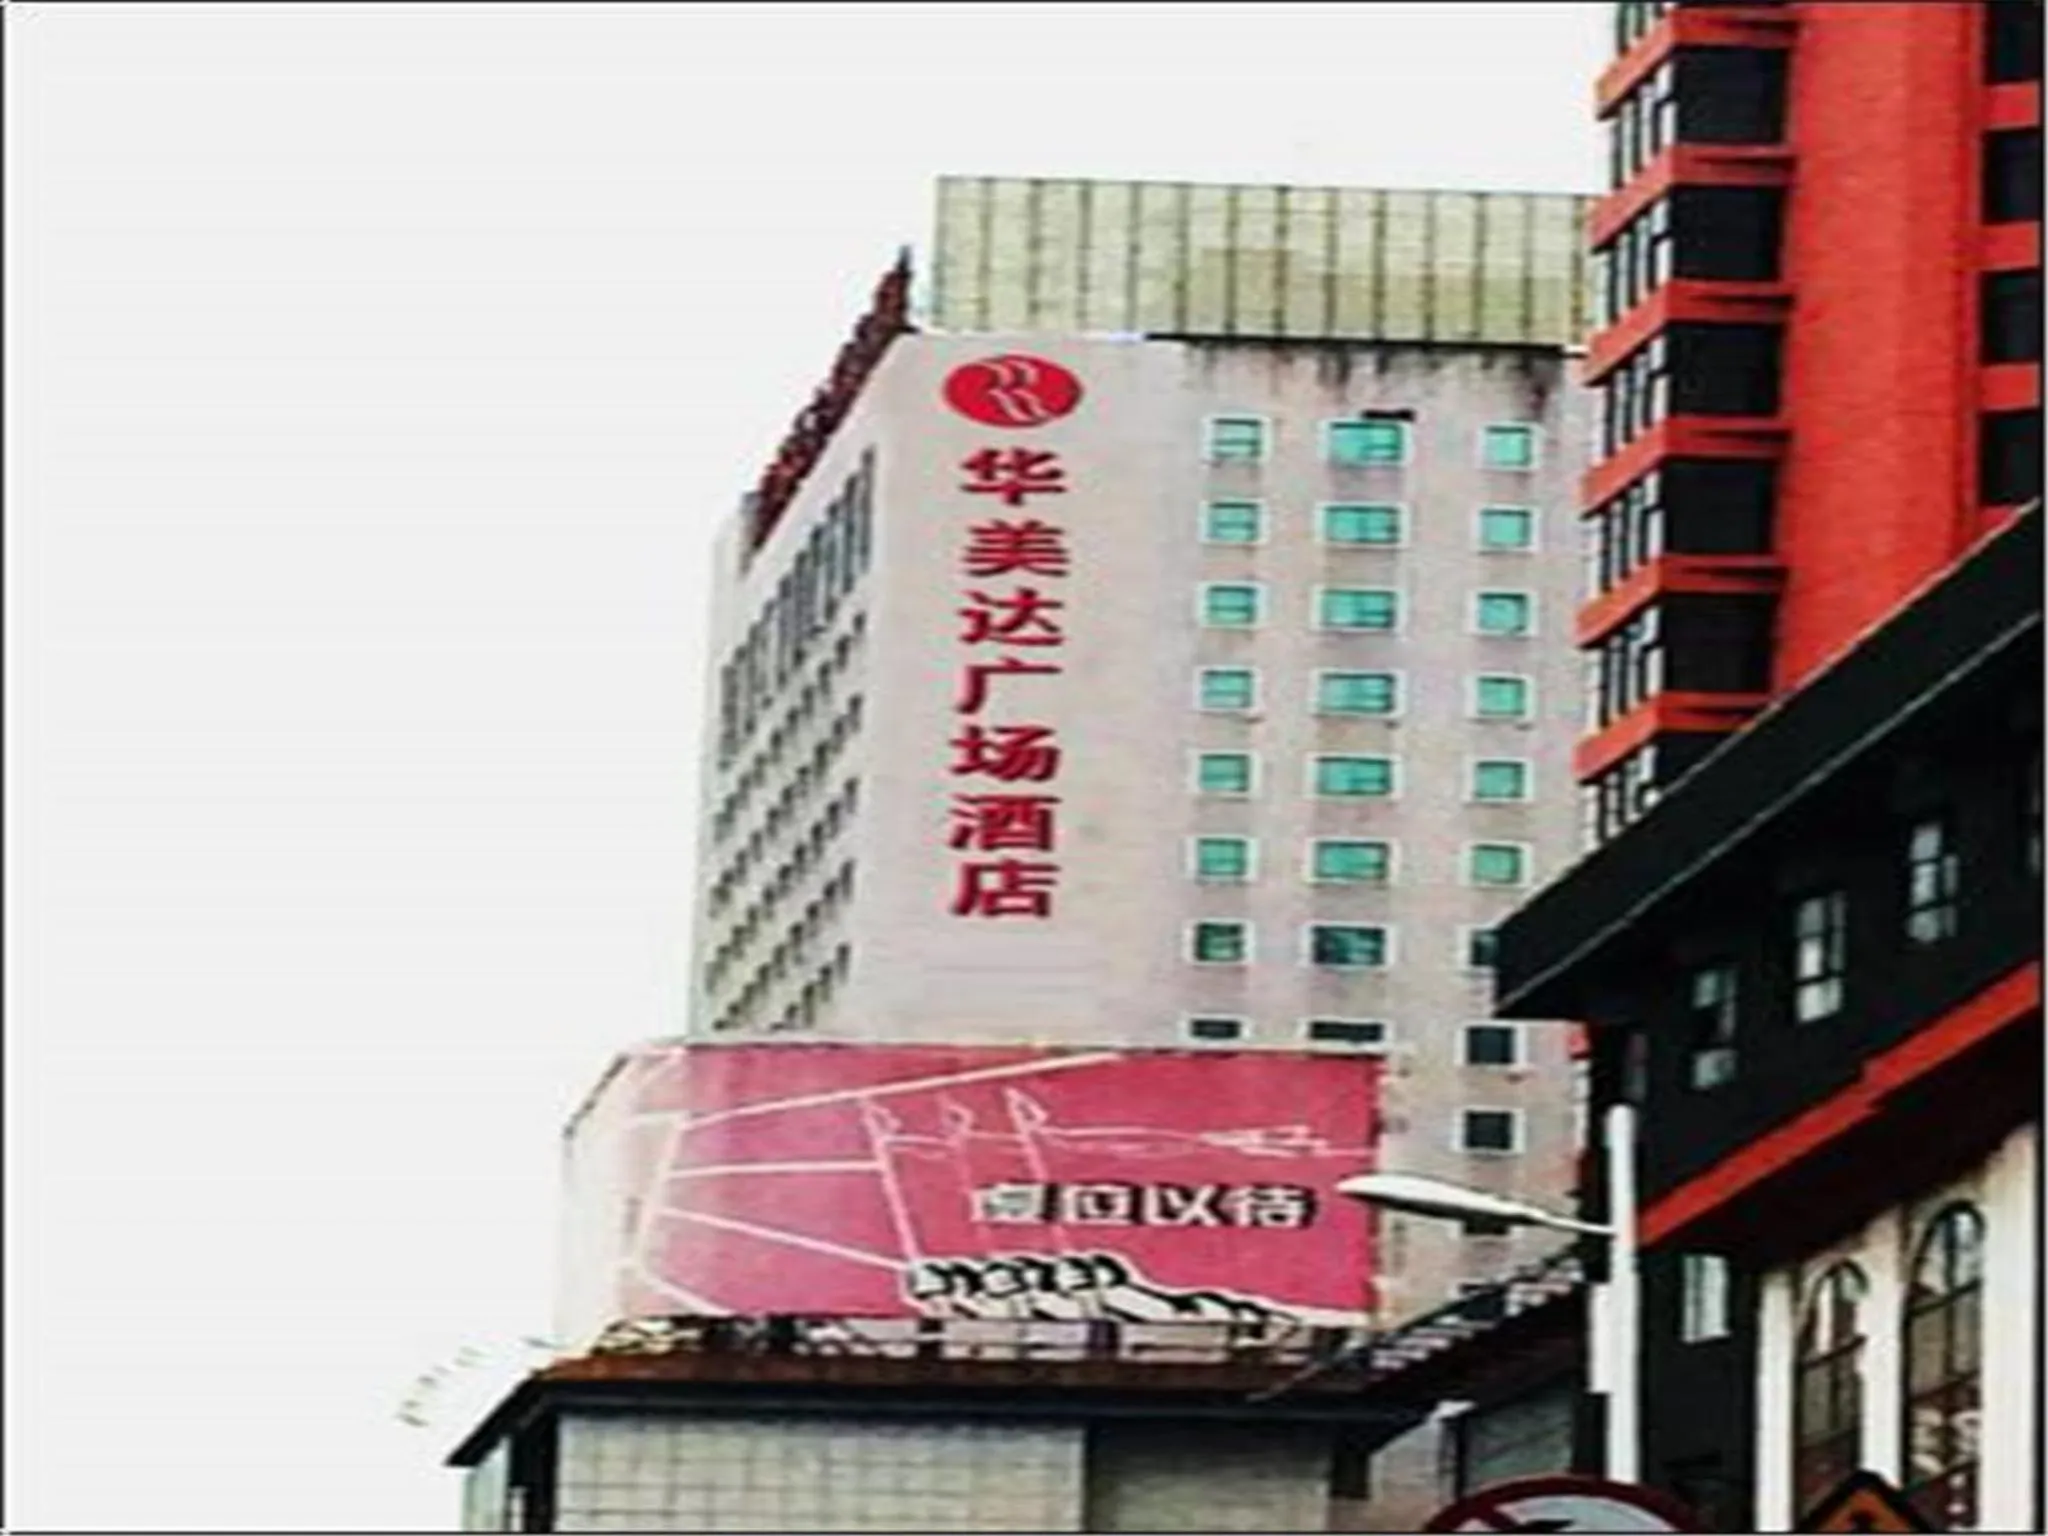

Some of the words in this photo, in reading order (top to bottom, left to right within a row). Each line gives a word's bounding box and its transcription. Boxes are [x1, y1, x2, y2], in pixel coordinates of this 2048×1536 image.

[949, 446, 1070, 920] 华美达广场酒店
